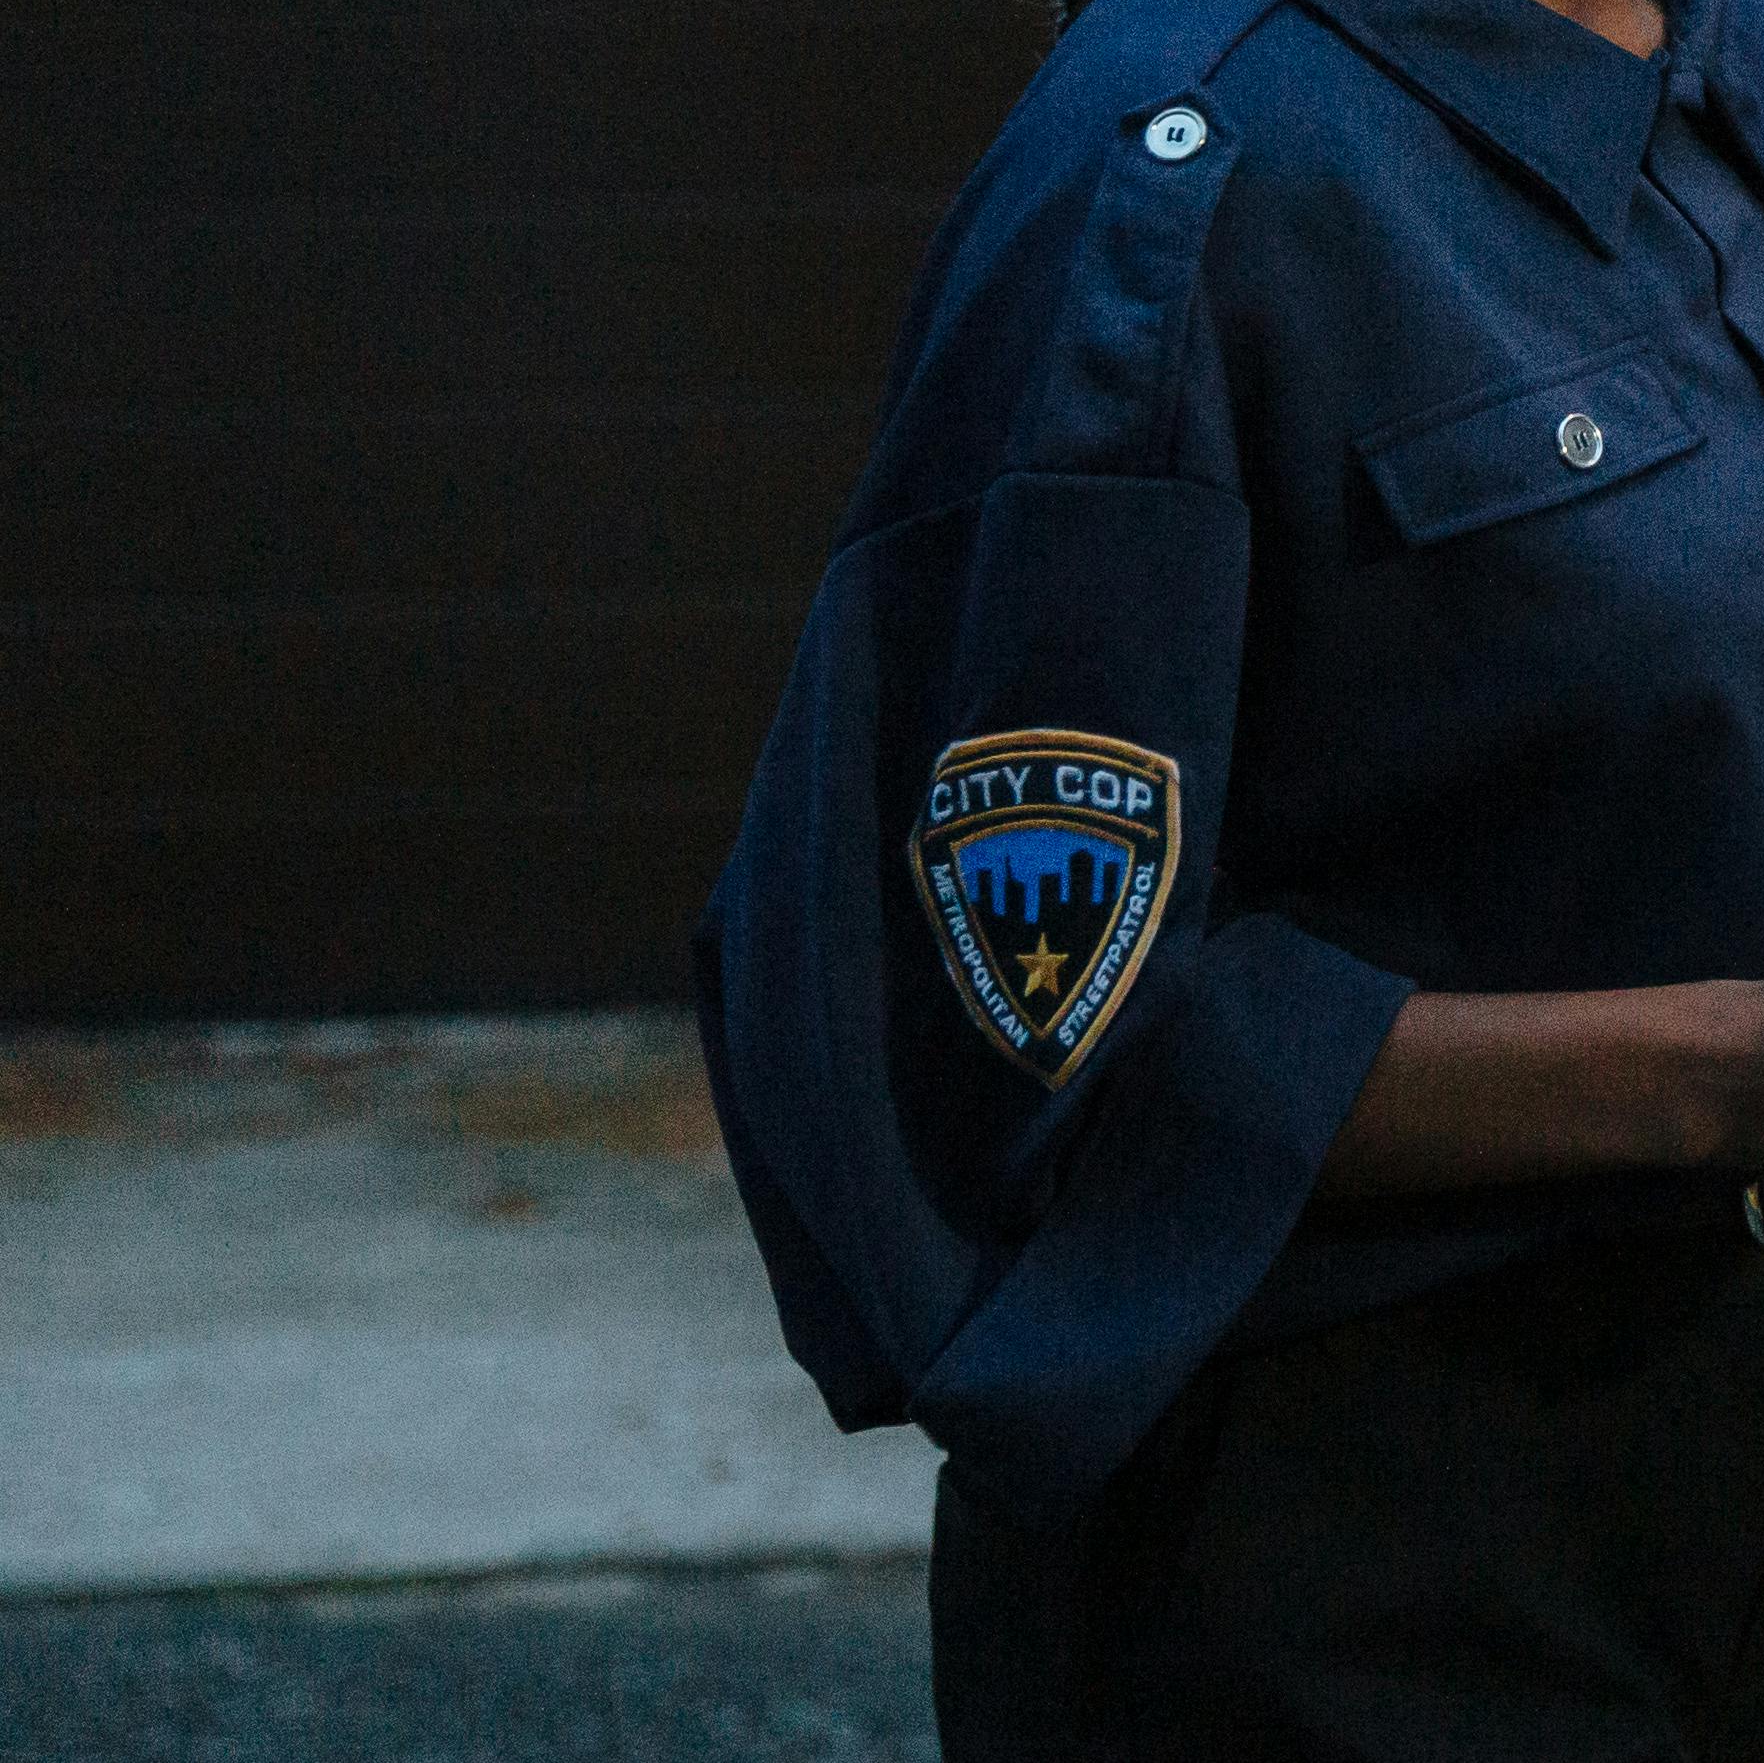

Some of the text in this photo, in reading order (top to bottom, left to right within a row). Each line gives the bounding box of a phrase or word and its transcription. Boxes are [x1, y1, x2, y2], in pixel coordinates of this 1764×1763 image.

[931, 765, 1153, 822] CITY COP
[930, 862, 1030, 1048] METROPOLITAN
